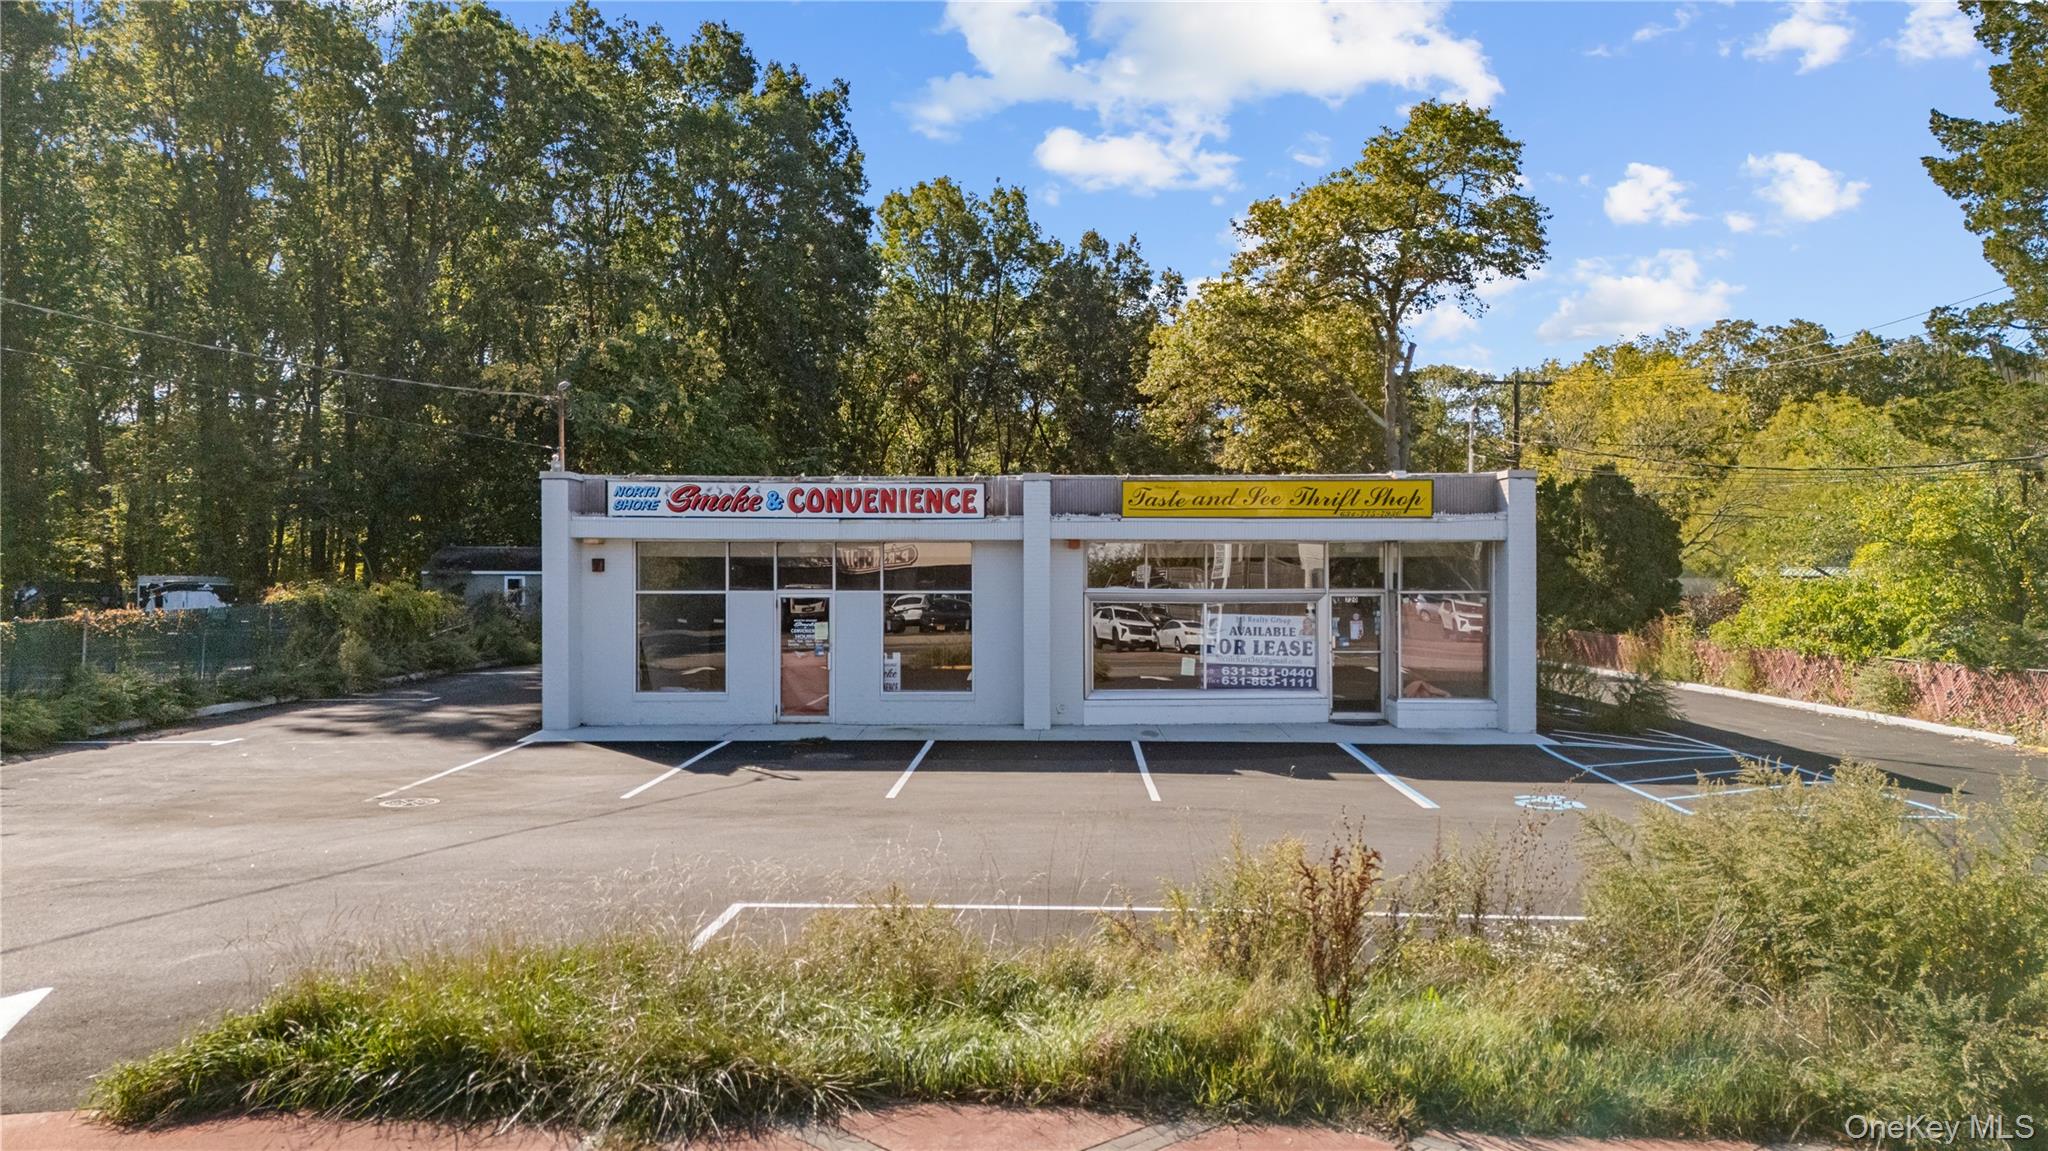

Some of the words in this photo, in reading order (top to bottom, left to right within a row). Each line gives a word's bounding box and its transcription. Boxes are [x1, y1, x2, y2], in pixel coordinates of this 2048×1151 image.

[613, 486, 661, 498] NORTH
[613, 499, 660, 511] SHORE
[665, 484, 763, 513] Smoke
[766, 490, 784, 511] &
[787, 487, 977, 514] CONVENIENCE
[1128, 487, 1187, 507] Taste
[1192, 487, 1239, 506] and
[1243, 486, 1281, 506] See
[1290, 486, 1361, 514] Thrift
[1364, 486, 1425, 514] Shop
[1229, 626, 1297, 637] AVAILABLE
[1206, 638, 1246, 655] FOR
[1253, 640, 1313, 656] LEASE
[1221, 666, 1314, 678] 631-831-0440
[1221, 676, 1313, 687] 631-863-1111
